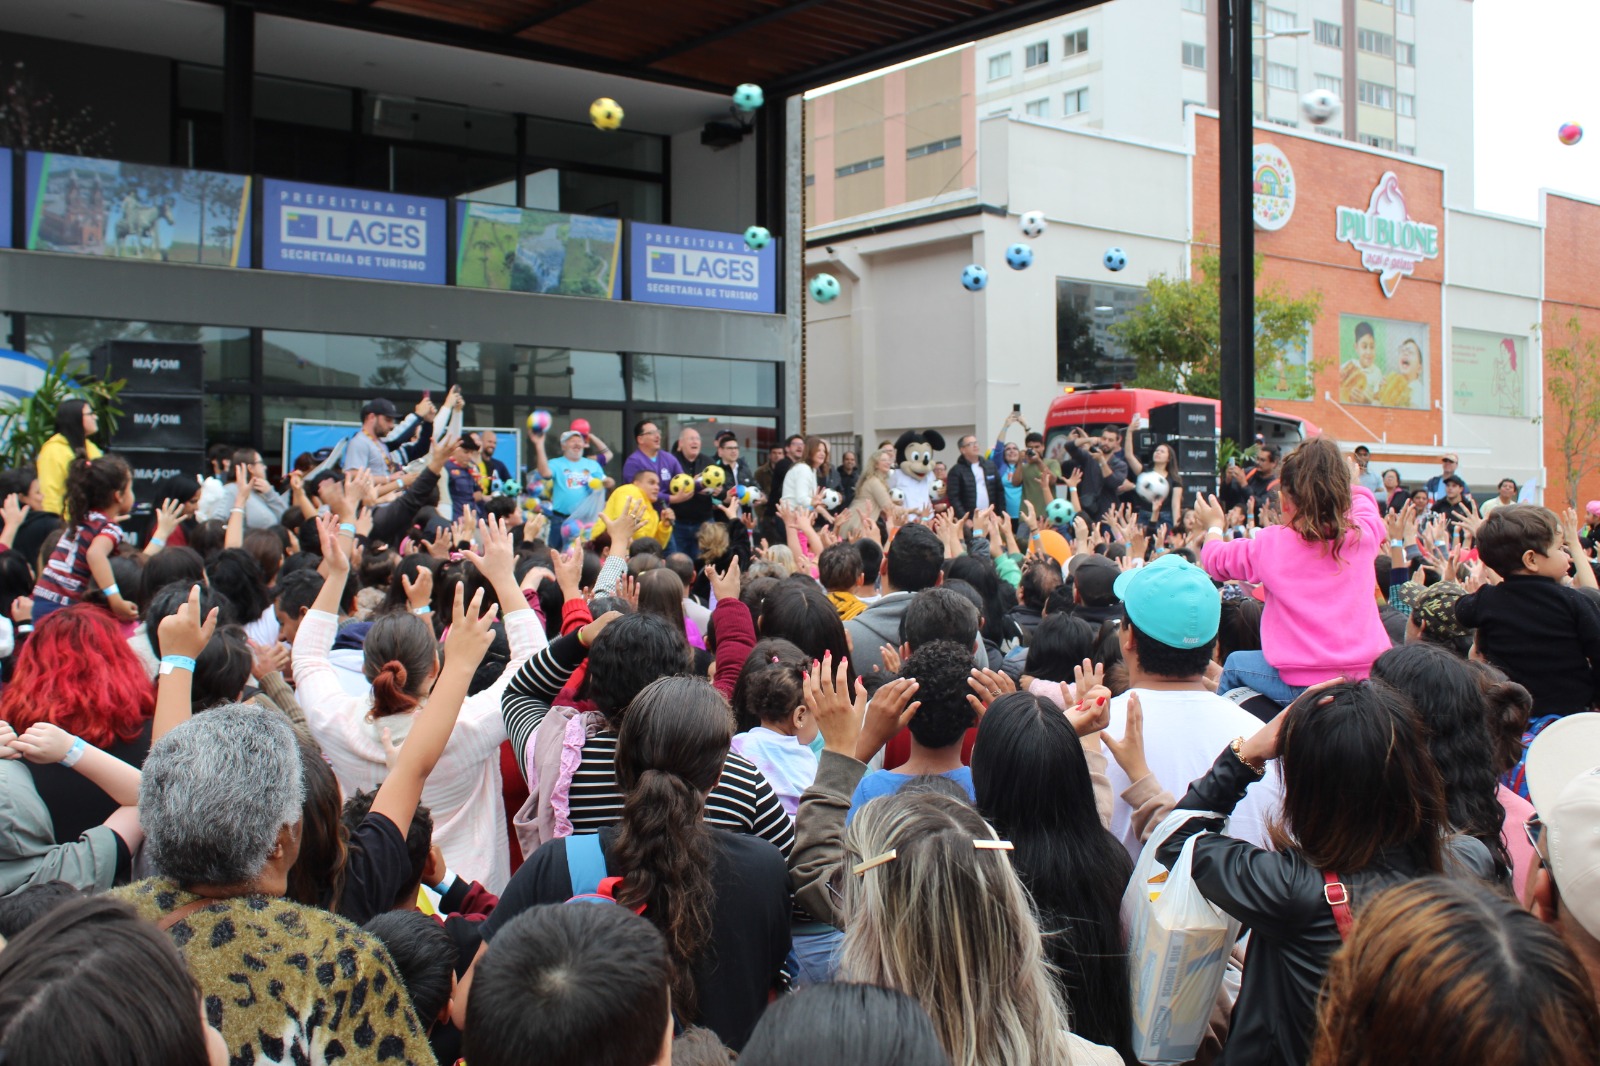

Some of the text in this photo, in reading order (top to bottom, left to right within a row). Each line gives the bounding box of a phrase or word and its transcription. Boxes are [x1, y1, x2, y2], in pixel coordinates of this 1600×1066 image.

[280, 191, 427, 216] PREFEITURA DE
[327, 216, 420, 249] LAGES
[645, 232, 734, 250] PREFEITURA
[1375, 217, 1439, 255] BUONE
[280, 248, 426, 271] SECRETARIA DE TURISMO
[682, 254, 754, 282] LAGES
[647, 283, 758, 301] SECRETARIA DE TURISMO
[1162, 965, 1178, 997] SCHOOL
[1171, 944, 1182, 962] BUS
